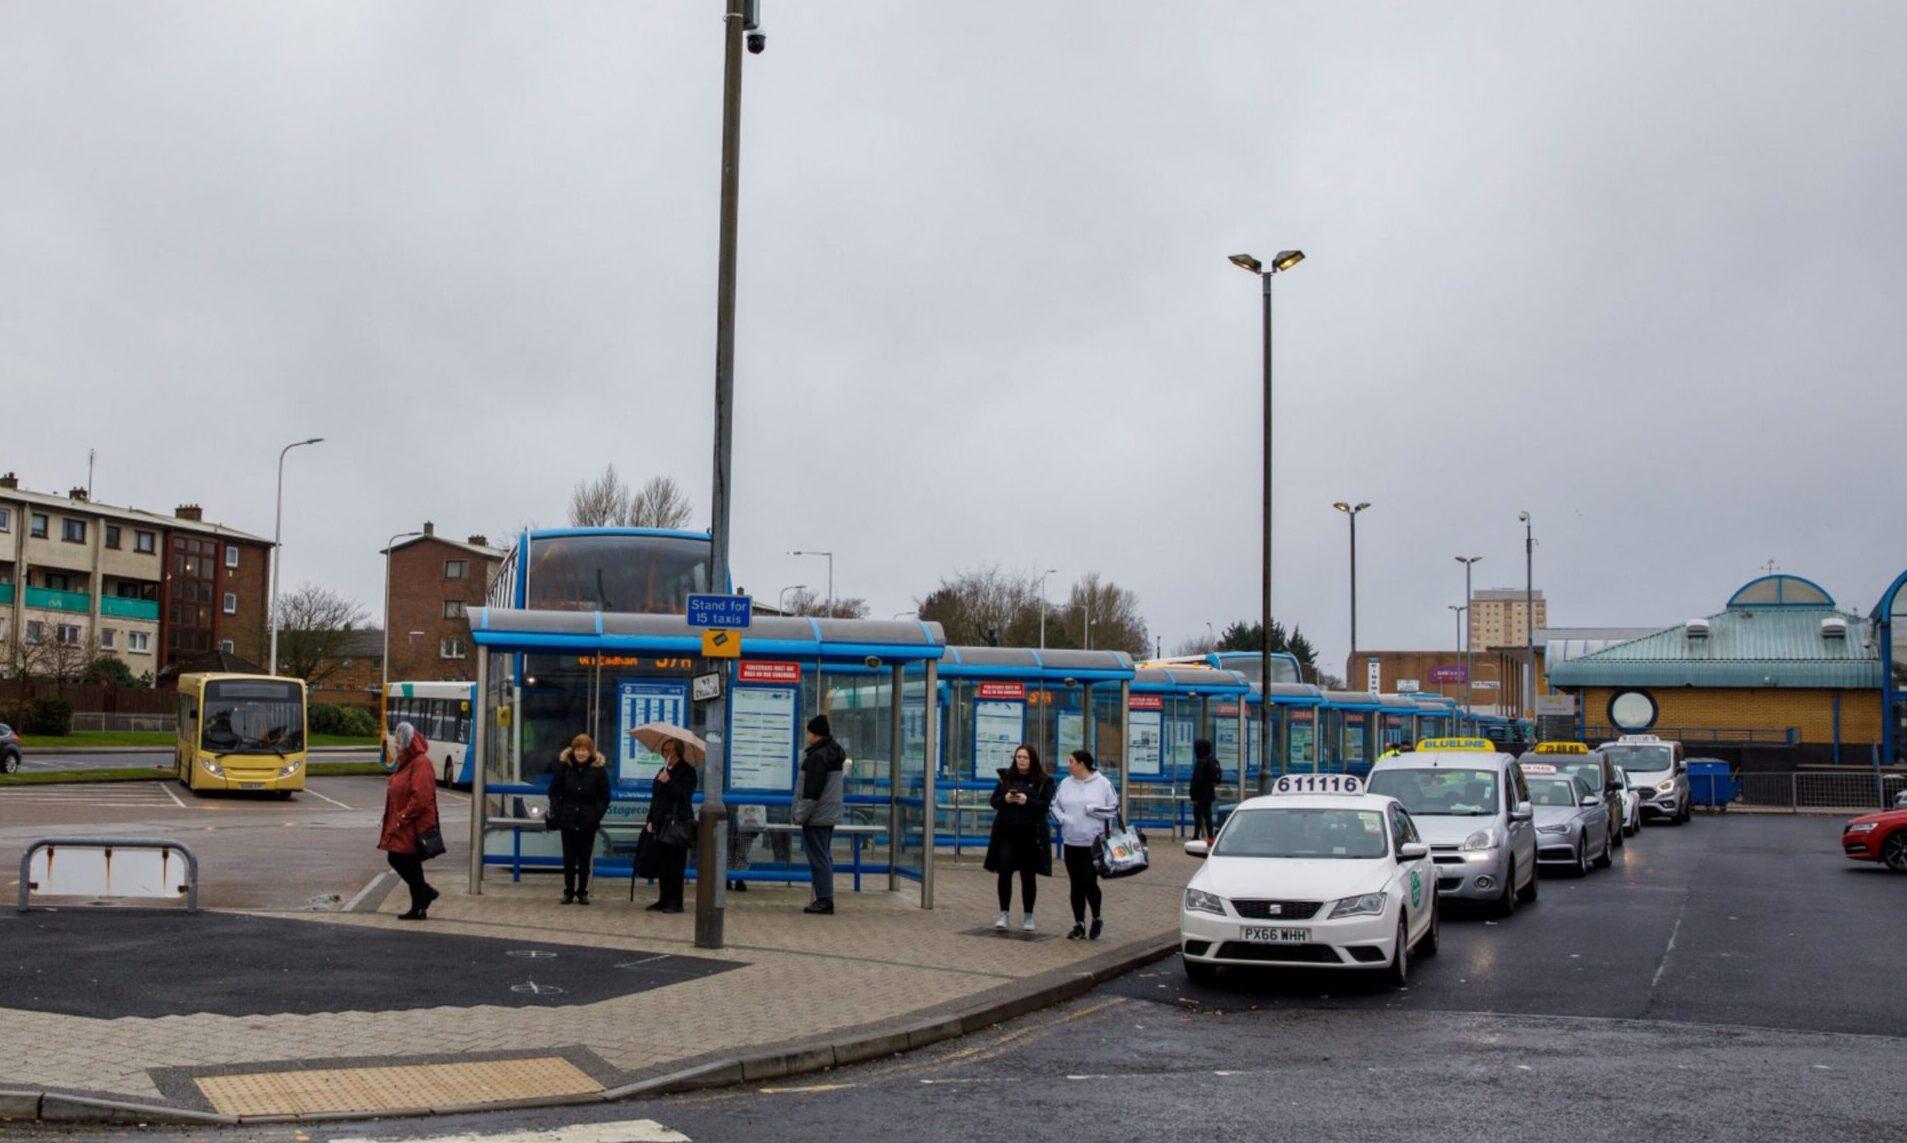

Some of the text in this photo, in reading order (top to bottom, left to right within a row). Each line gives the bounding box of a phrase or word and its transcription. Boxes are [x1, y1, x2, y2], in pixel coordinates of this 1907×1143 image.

[691, 599, 747, 612] Stand for
[696, 612, 742, 625] 15 taxis
[1424, 739, 1486, 749] BLUELINE
[1278, 777, 1357, 792] 611116
[607, 804, 649, 817] Stageco
[1245, 927, 1306, 941] PX66 WHH
